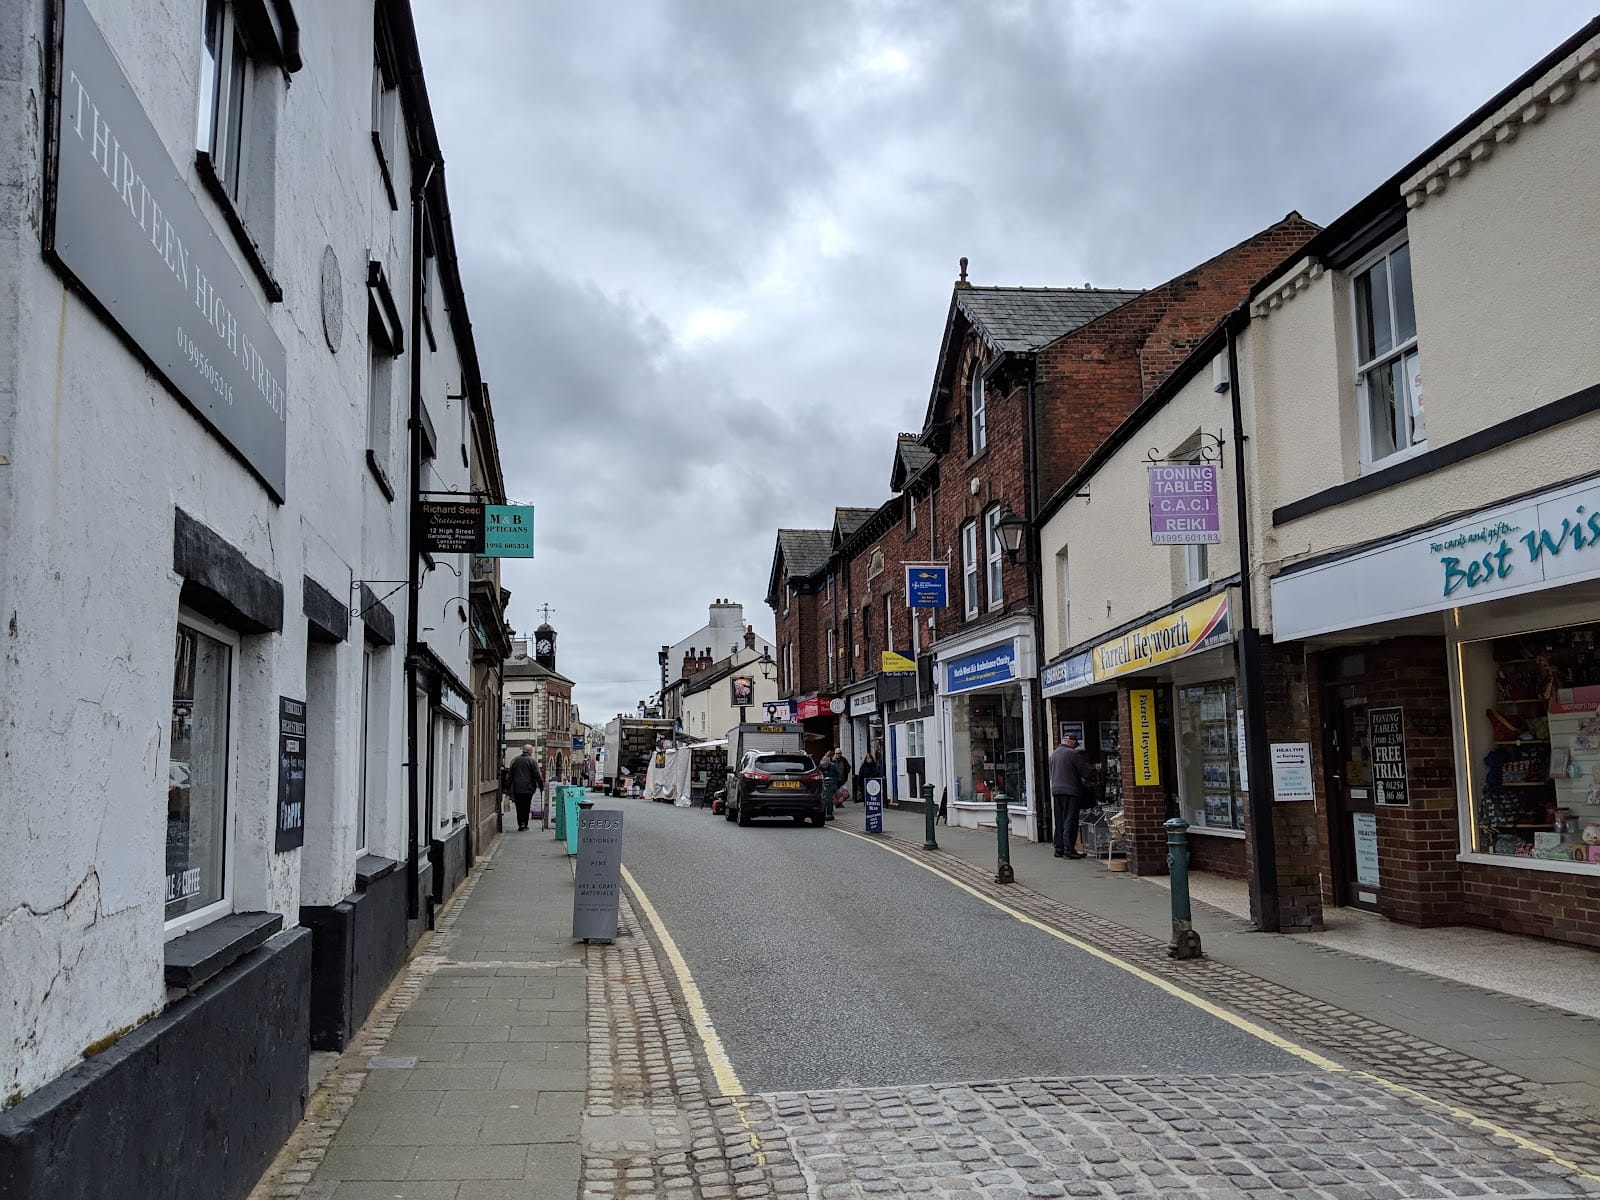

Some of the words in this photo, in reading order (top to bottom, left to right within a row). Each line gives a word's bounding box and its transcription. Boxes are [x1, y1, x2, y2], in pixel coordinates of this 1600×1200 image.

[71, 71, 189, 292] THIRTEEN
[195, 264, 239, 358] HIGH
[242, 333, 286, 423] STREET
[177, 326, 234, 406] 01995605216
[1153, 467, 1213, 480] TONING
[1154, 480, 1213, 493] TABLES
[423, 504, 457, 514] Richard
[458, 505, 481, 515] Seed
[1160, 498, 1209, 511] C.A.C.I
[490, 514, 500, 524] M
[512, 514, 522, 525] B
[1166, 518, 1206, 531] REIKI
[438, 527, 454, 535] High
[1155, 534, 1183, 542] 01995
[1429, 542, 1443, 554] For
[1444, 533, 1467, 549] cards
[1467, 526, 1487, 542] and
[1440, 539, 1513, 597] Best
[1100, 636, 1131, 670] Farrell
[1132, 615, 1190, 663] Heyworth
[1139, 694, 1150, 728] Farrell
[1372, 713, 1400, 724] TONING
[1373, 722, 1399, 734] TABLES
[1372, 734, 1387, 747] from
[1140, 731, 1152, 781] Heyworth
[1375, 745, 1402, 762] FREE
[1374, 763, 1406, 779] TRIAL
[581, 820, 621, 830] SEEDS
[182, 867, 201, 896] COFFEE
